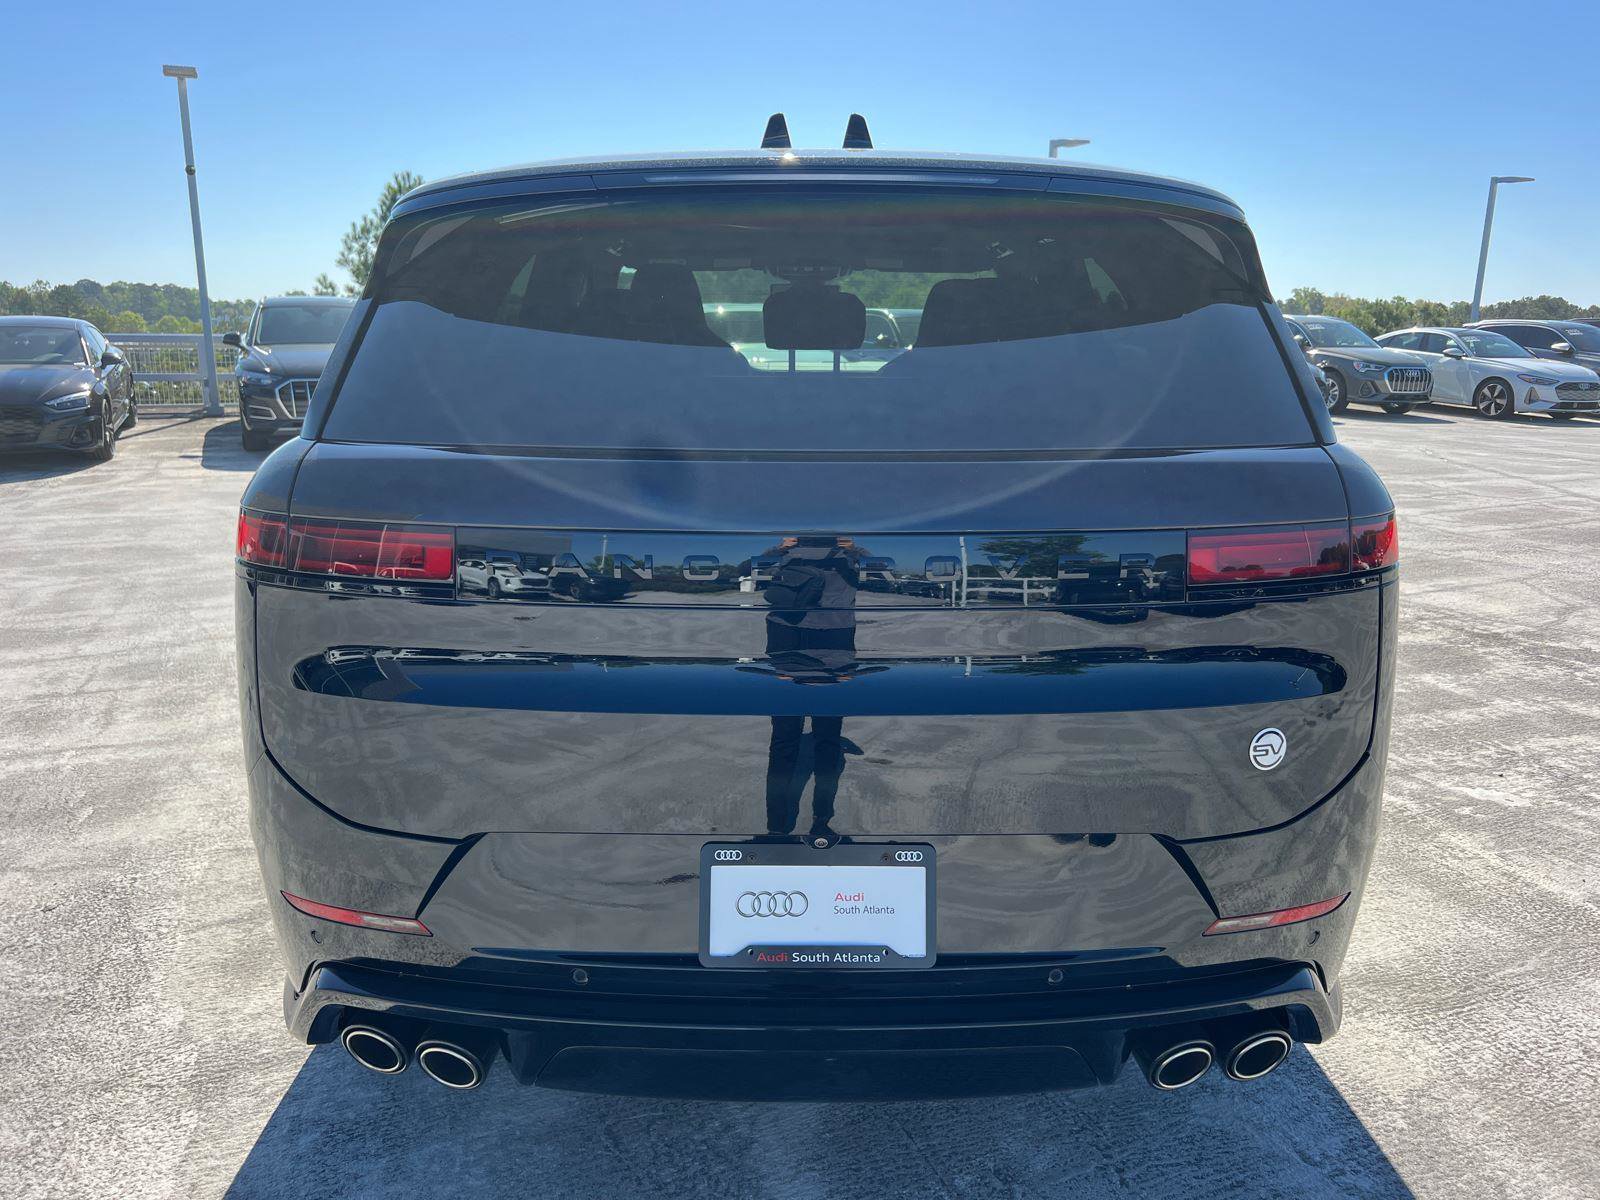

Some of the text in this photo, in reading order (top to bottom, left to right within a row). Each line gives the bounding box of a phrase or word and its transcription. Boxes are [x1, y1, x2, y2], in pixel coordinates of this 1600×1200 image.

[485, 550, 1156, 582] RANGE ROVER
[834, 892, 865, 902] Audi
[833, 905, 895, 915] South Atlanta
[757, 952, 881, 964] Audi South Atlanta
